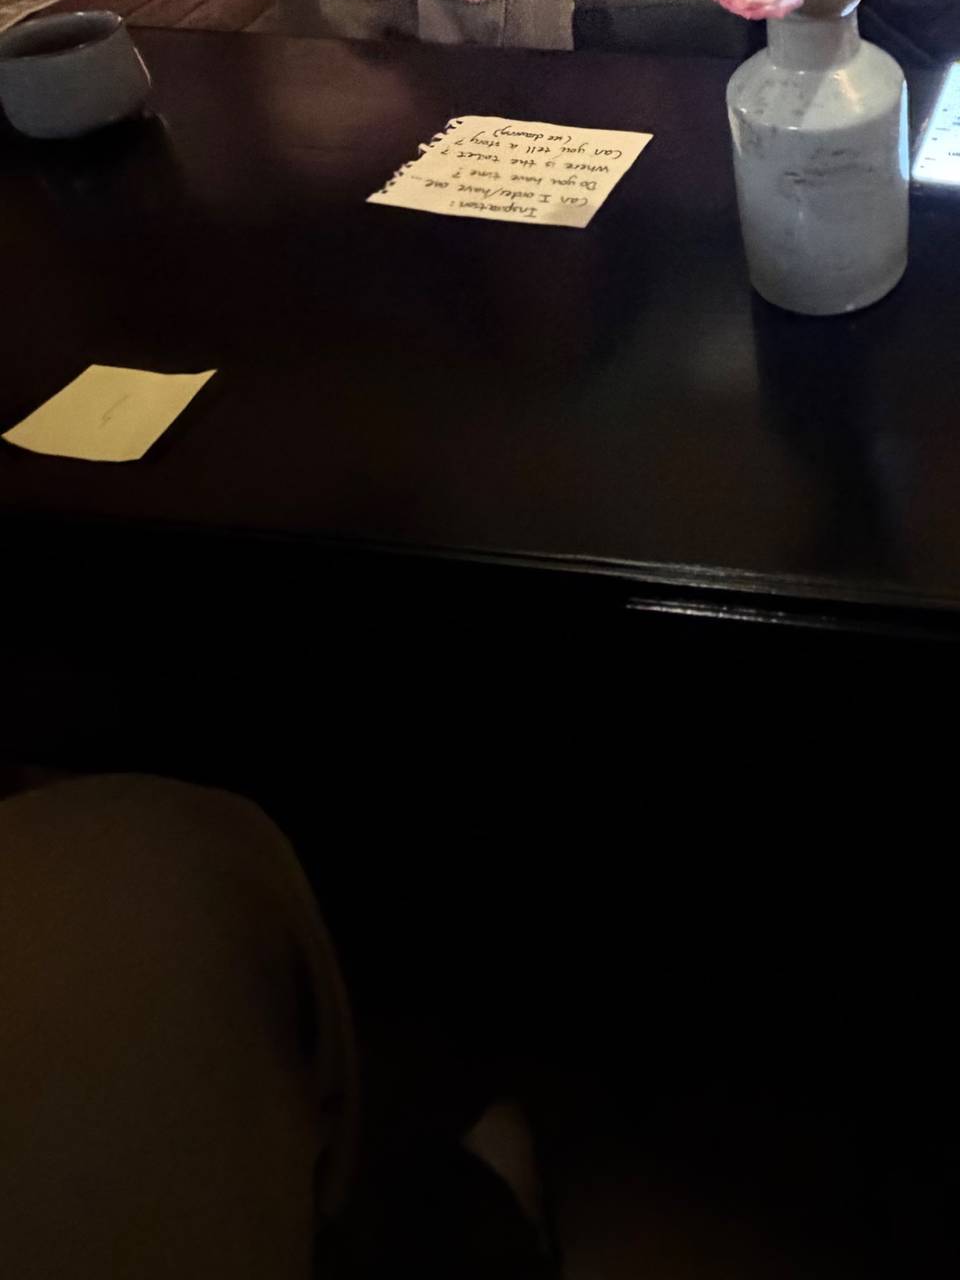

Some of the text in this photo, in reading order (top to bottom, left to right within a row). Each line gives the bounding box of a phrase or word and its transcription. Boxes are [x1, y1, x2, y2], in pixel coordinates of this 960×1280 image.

[509, 142, 519, 150] a
[526, 146, 552, 154] tell
[561, 142, 589, 154] you
[594, 148, 623, 160] Can
[511, 159, 537, 167] the
[511, 175, 543, 185] have
[551, 175, 578, 186] you
[580, 181, 598, 191] Do
[539, 194, 552, 203] I
[560, 196, 589, 207] Can
